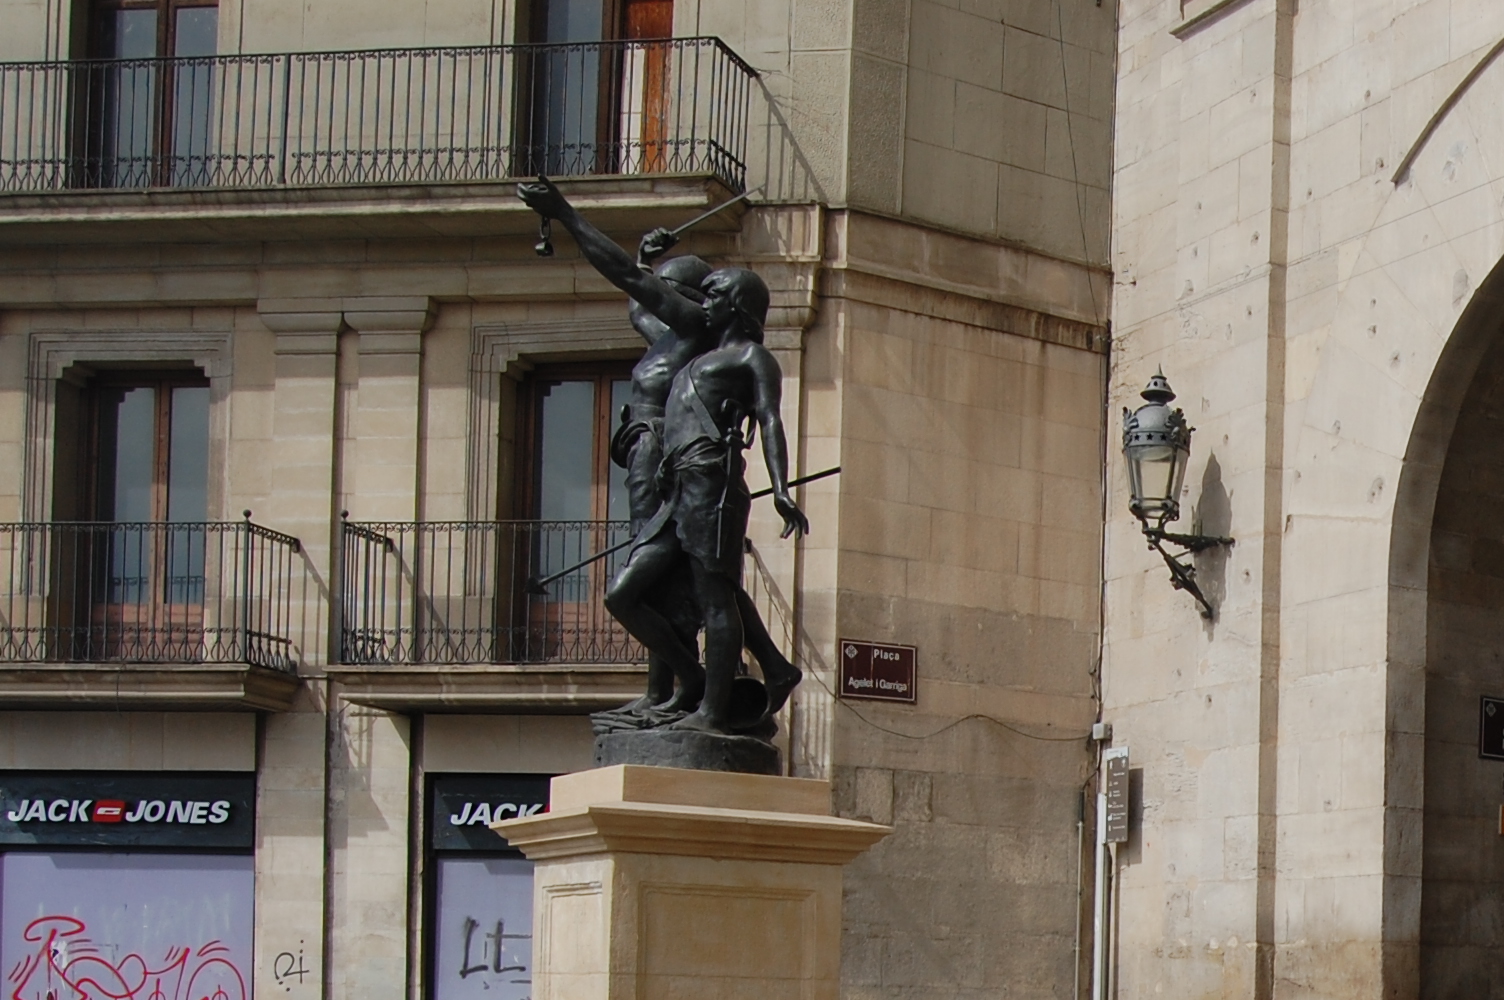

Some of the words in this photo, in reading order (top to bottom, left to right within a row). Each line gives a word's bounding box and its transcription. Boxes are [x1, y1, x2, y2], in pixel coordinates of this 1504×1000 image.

[873, 649, 899, 660] Plaça
[7, 799, 93, 823] JACK
[125, 799, 231, 825] JONES
